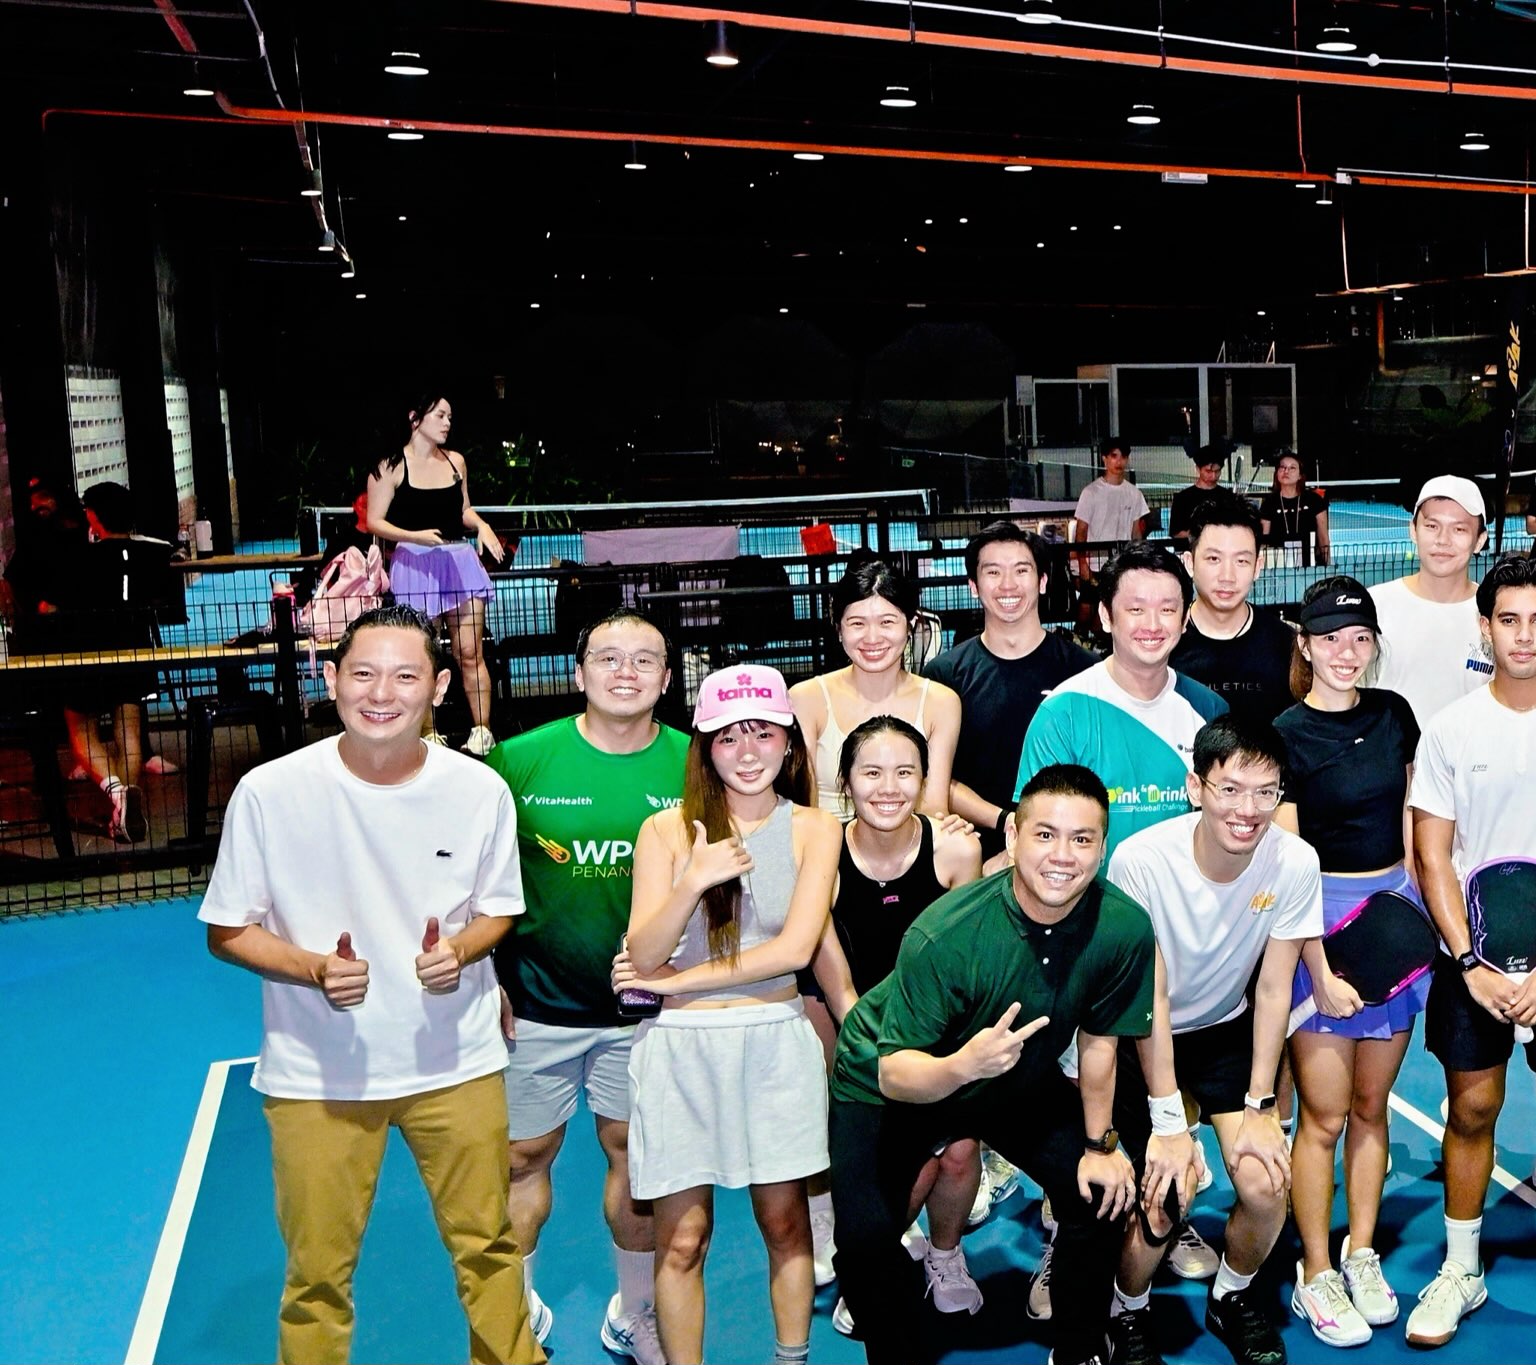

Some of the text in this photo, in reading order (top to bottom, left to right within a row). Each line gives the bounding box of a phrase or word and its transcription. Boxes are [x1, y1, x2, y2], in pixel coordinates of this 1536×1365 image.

[1465, 658, 1495, 676] PUMA
[713, 687, 773, 702] tama
[535, 796, 594, 807] VitaHealth
